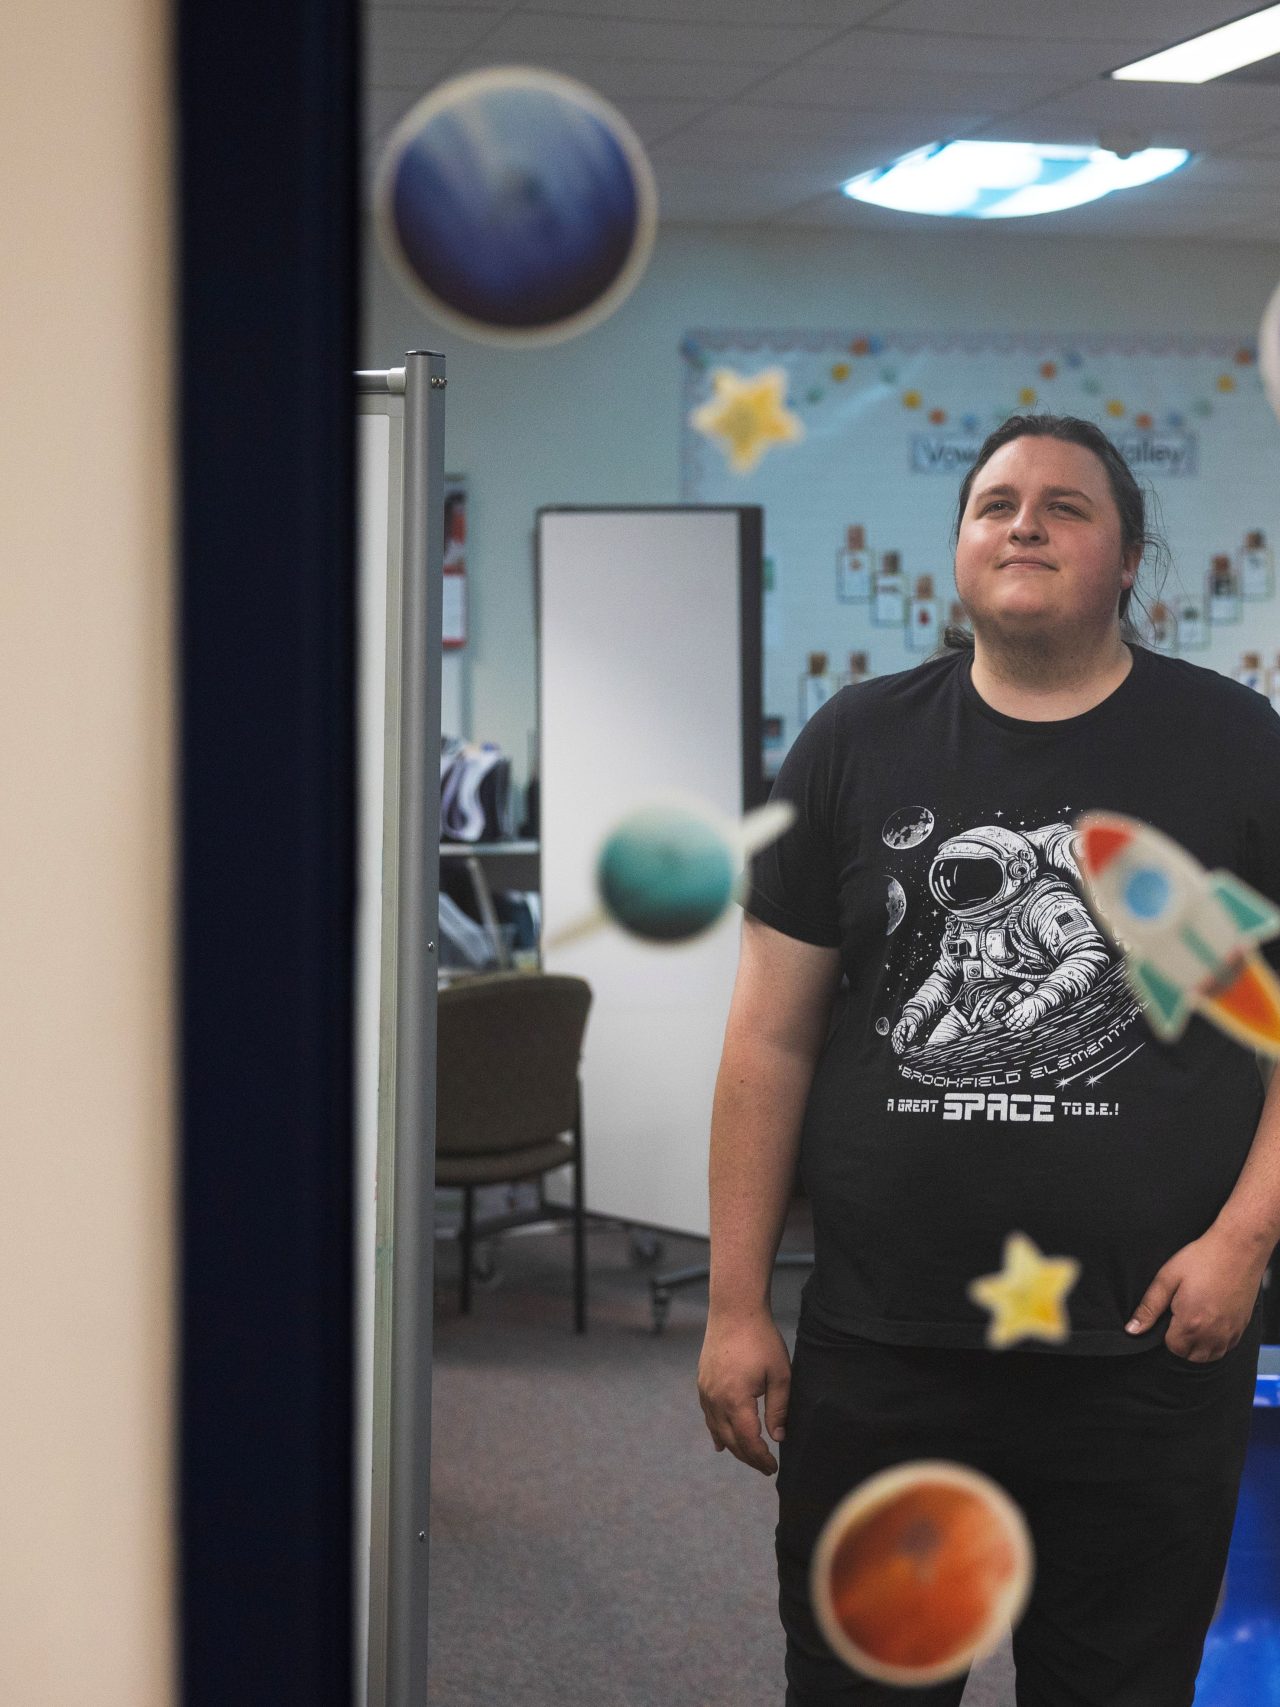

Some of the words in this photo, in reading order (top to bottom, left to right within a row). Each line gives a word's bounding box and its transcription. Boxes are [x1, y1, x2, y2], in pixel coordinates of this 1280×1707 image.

[901, 1066, 1021, 1089] BROOKFIELD
[887, 1099, 894, 1111] A
[898, 1099, 938, 1112] GREAT
[943, 1093, 1055, 1122] SPACE
[1062, 1102, 1081, 1115] TO
